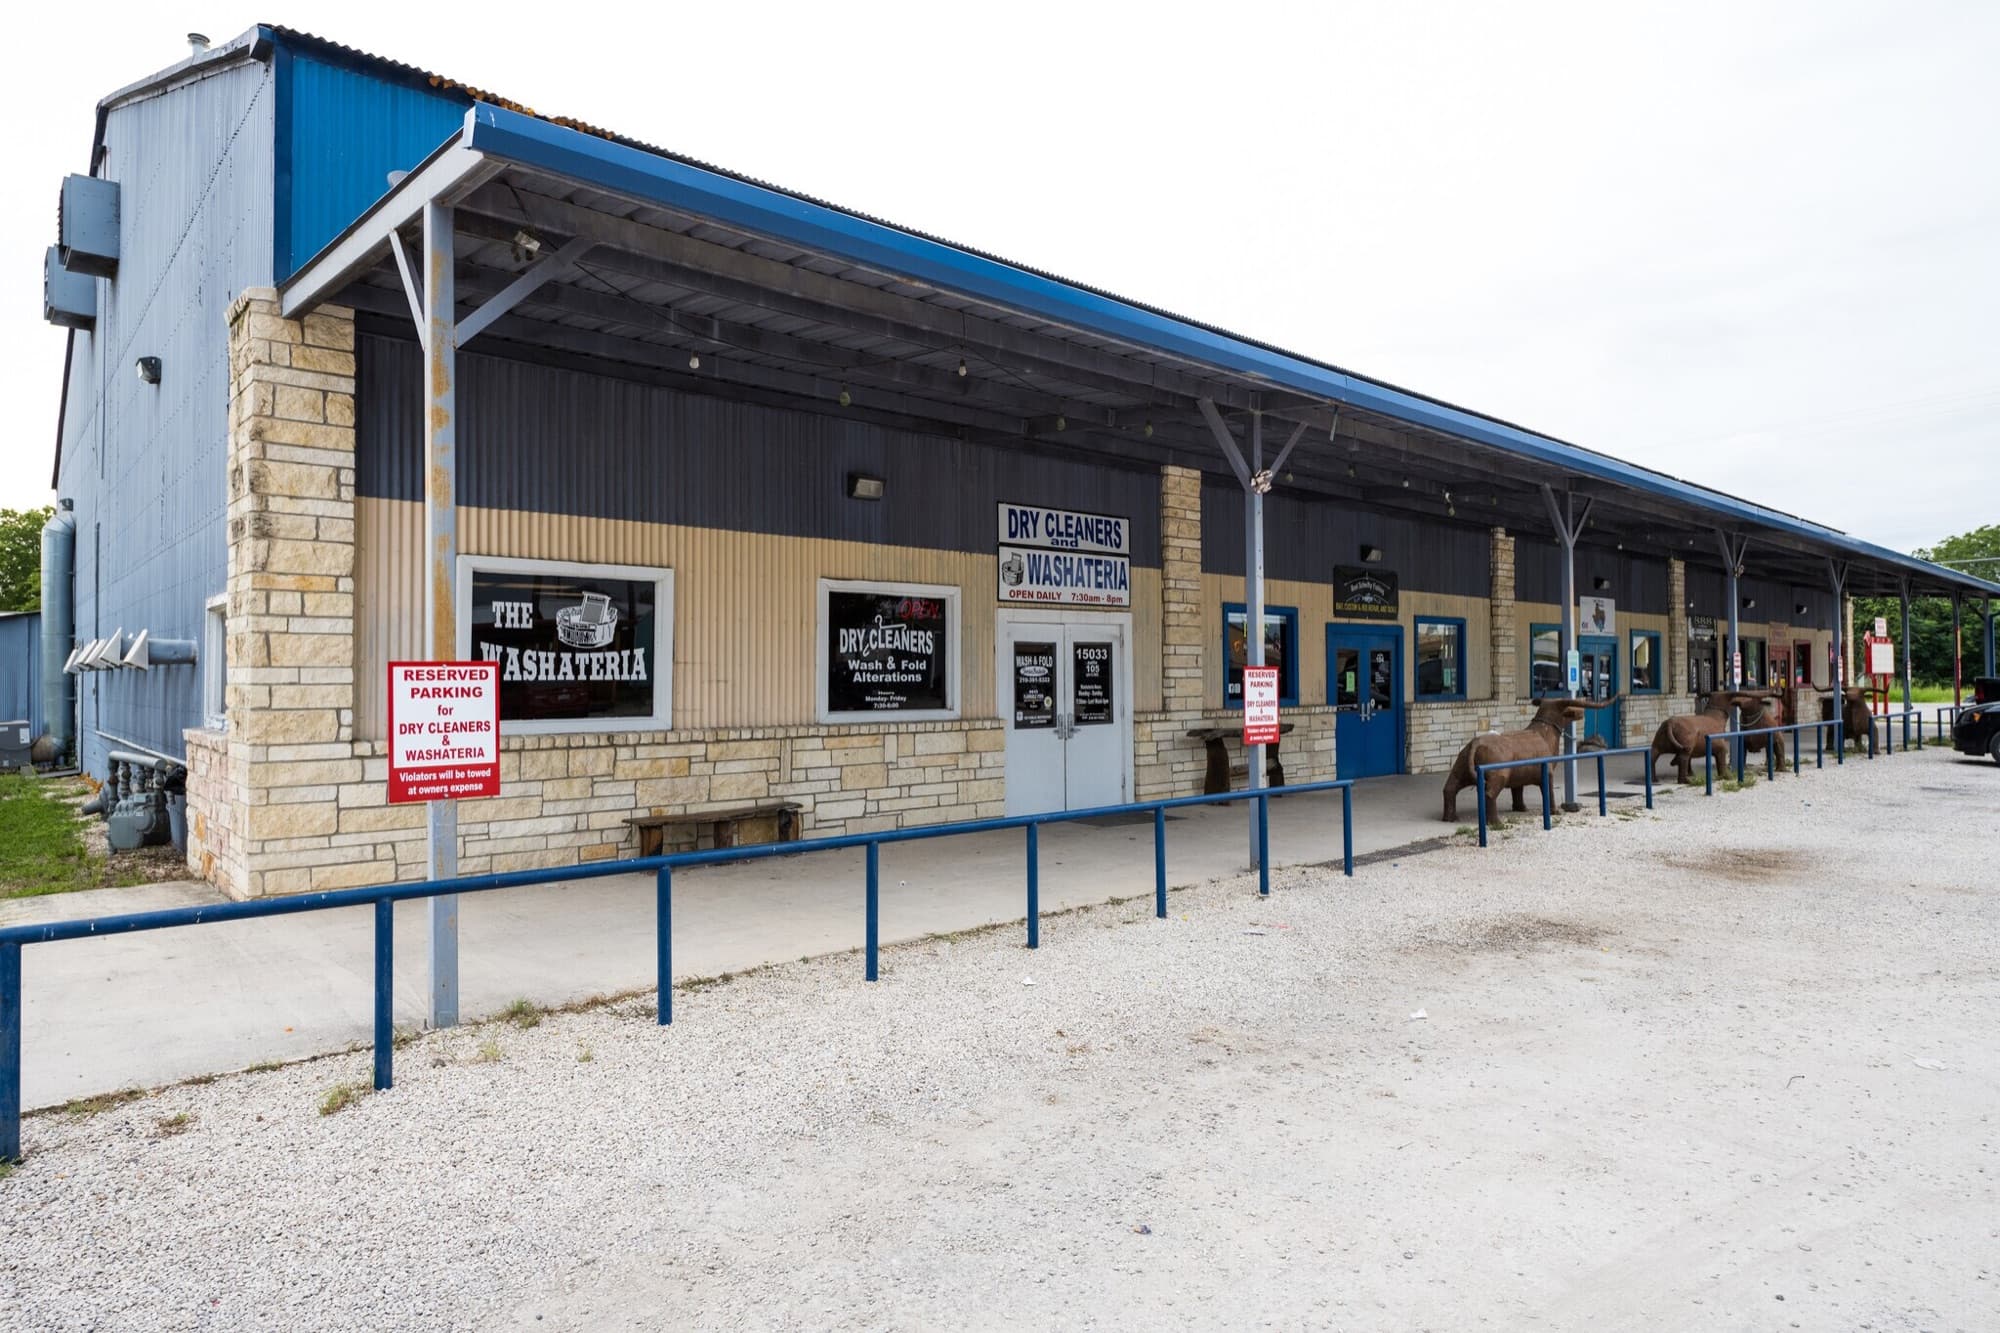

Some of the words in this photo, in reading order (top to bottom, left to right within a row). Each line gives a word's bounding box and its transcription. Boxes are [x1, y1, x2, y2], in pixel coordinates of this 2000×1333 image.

[1008, 508, 1040, 538] DRY
[1045, 512, 1122, 548] CLEANERS
[1050, 538, 1079, 547] and
[1027, 553, 1128, 590] WASHATERIA
[1009, 590, 1035, 599] OPEN
[1036, 591, 1062, 600] DAILY
[1072, 593, 1100, 602] 7:30am
[1106, 594, 1123, 604] 8pm
[492, 601, 533, 629] THE
[900, 600, 940, 620] OPEN
[840, 628, 866, 653] DRY
[869, 629, 933, 655] CLEANERS
[1076, 648, 1108, 660] 15033
[848, 660, 882, 670] Wash
[886, 656, 896, 670] &
[902, 660, 926, 670] Fold
[1016, 656, 1033, 667] WASH
[1039, 656, 1053, 667] FOLD
[404, 670, 488, 681] RESERVED
[853, 673, 922, 682] Alterations
[410, 686, 483, 699] PARKING
[438, 705, 454, 716] for
[400, 723, 424, 735] DRY
[428, 720, 490, 734] CLEANERS
[442, 735, 450, 746] &
[406, 747, 484, 761] WASHATERIA
[399, 771, 437, 782] Violators
[439, 770, 453, 780] will
[455, 769, 466, 778] be
[467, 768, 491, 778] towed
[408, 786, 416, 795] at
[419, 785, 448, 794] owners
[450, 782, 483, 793] expense
